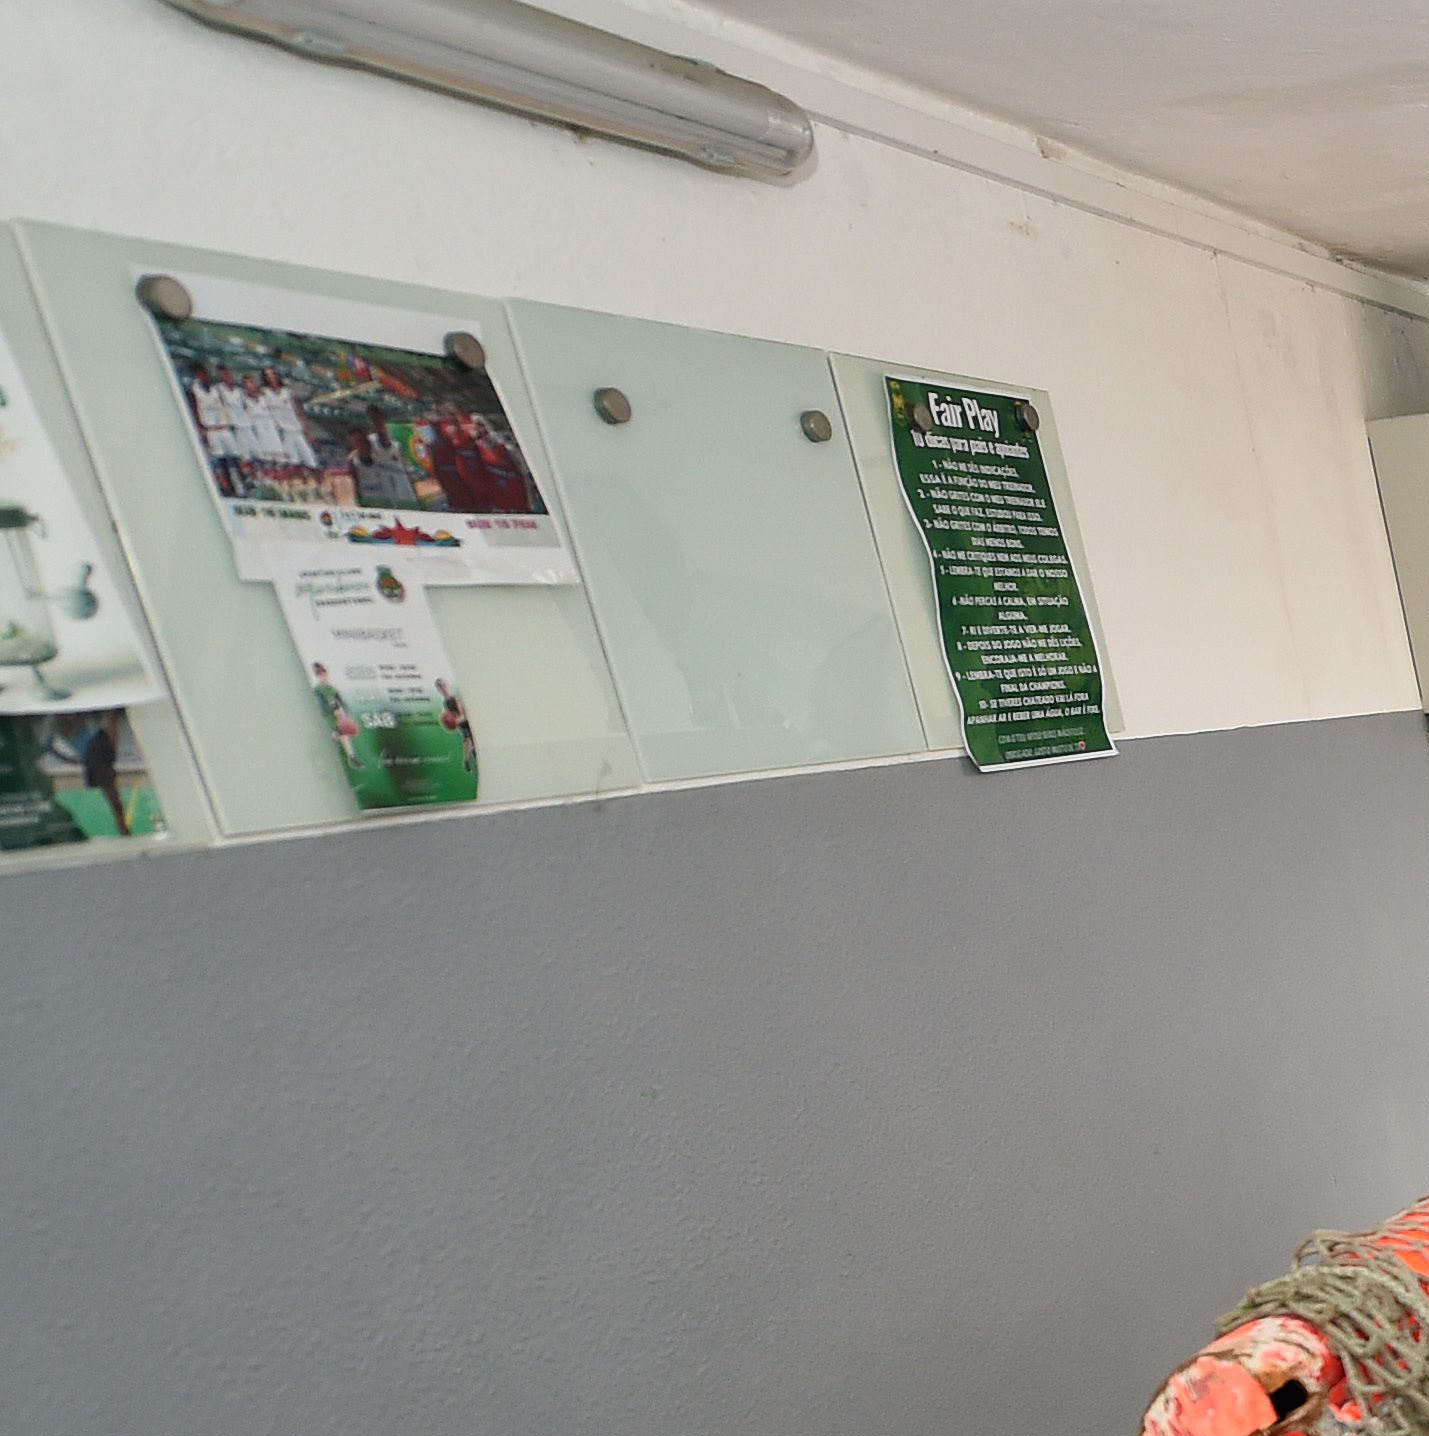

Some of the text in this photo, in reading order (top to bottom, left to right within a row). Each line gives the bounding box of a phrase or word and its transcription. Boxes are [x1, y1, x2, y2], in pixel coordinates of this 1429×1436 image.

[928, 392, 1000, 438] Fair Play
[910, 430, 924, 447] 10
[925, 432, 951, 450] dicas
[950, 436, 969, 454] para
[970, 436, 988, 455] pais
[988, 442, 994, 454] e
[361, 712, 396, 728] SAB
